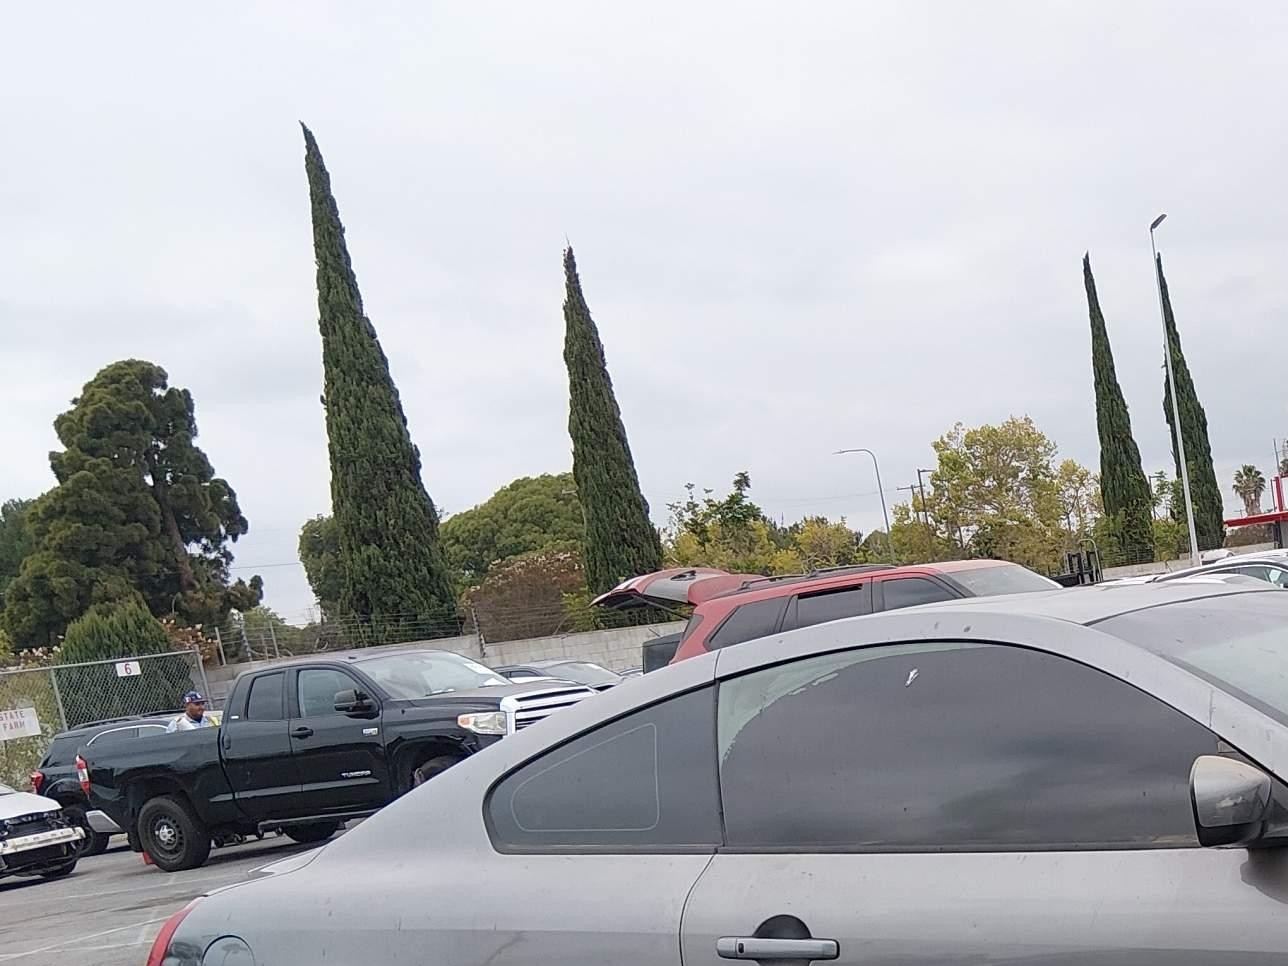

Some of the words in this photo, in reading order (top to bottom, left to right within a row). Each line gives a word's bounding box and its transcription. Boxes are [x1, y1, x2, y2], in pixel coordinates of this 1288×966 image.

[124, 663, 132, 675] 6
[0, 710, 25, 721] STATE
[3, 720, 25, 731] FARM
